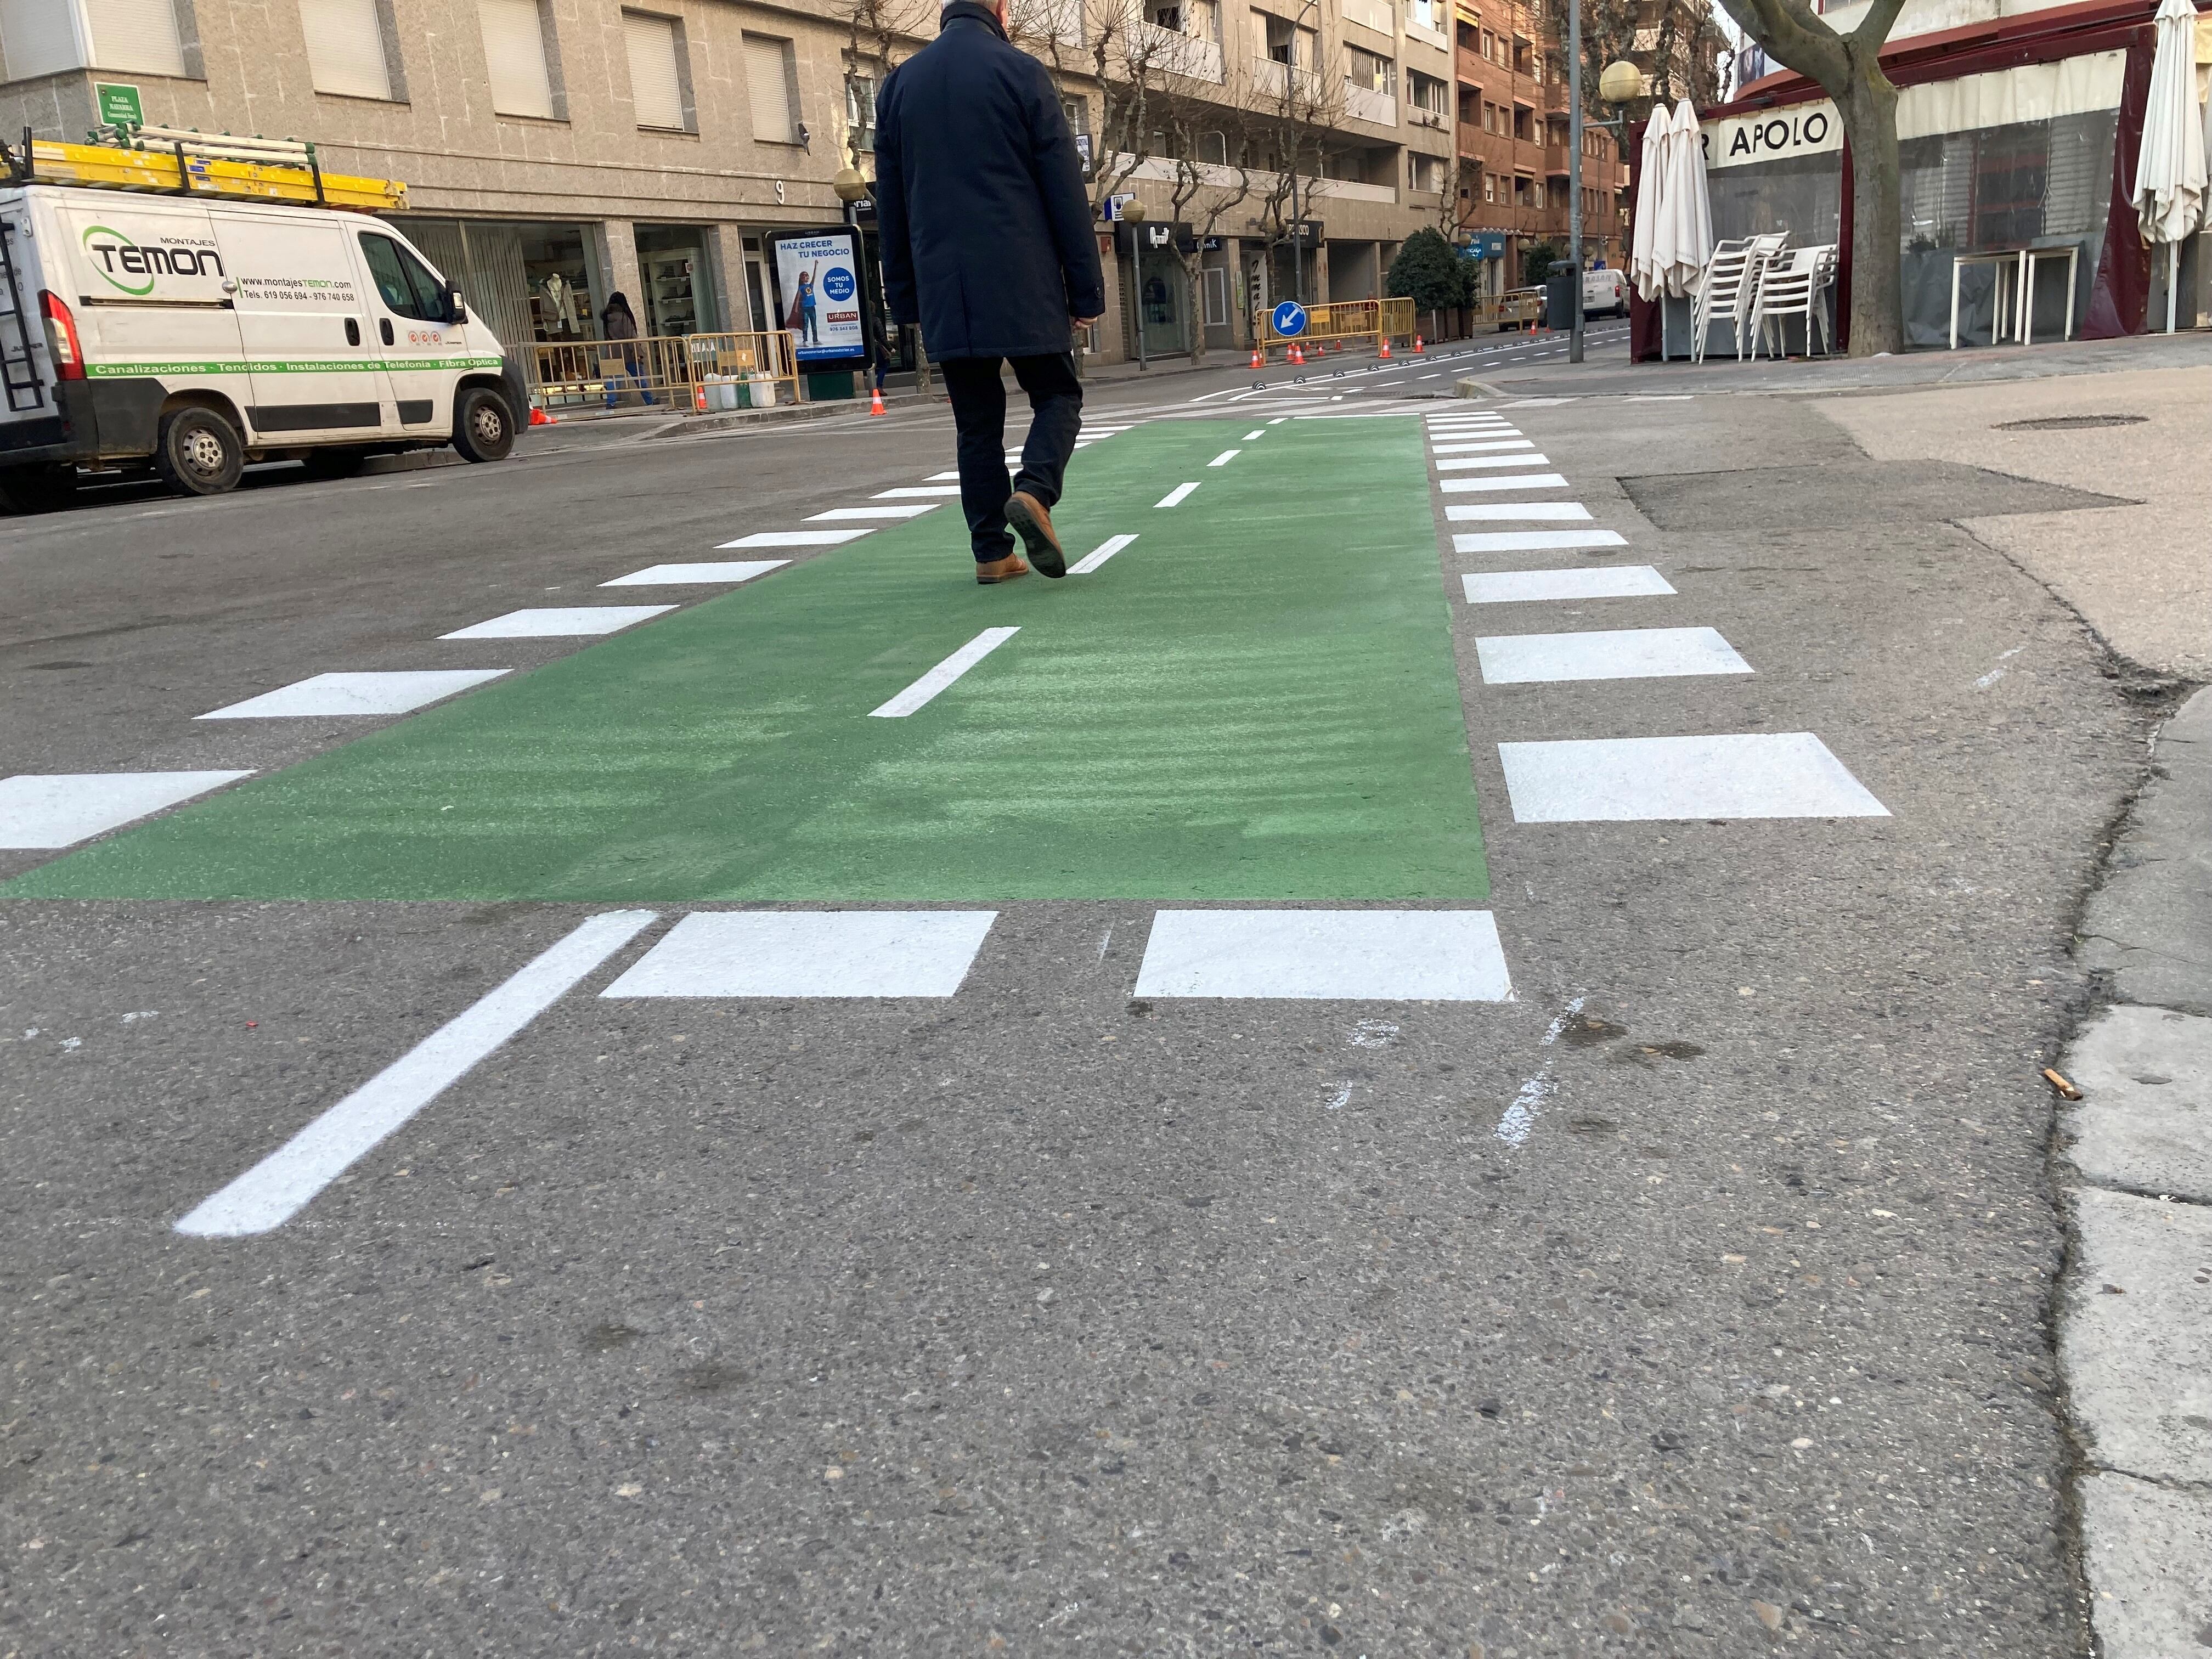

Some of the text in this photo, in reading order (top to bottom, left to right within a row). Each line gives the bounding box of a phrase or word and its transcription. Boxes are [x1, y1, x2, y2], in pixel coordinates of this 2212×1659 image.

[1729, 112, 1828, 157] APOLO
[775, 180, 785, 205] 9
[160, 237, 216, 246] MONTAJES
[799, 240, 833, 249] CRECER
[811, 248, 850, 257] NEGOCIO
[91, 244, 224, 277] TEMON
[241, 278, 351, 289] www.montajesTEMON.com
[244, 290, 263, 299] Tels.
[264, 291, 277, 299] 619
[279, 291, 292, 300] 056
[294, 292, 307, 300] 694
[313, 292, 326, 301] 976
[329, 292, 340, 301] 740
[95, 364, 206, 375] Canalizaciones
[216, 363, 278, 372] Tendidos
[286, 362, 365, 371] Instalaciones
[367, 361, 381, 369] de
